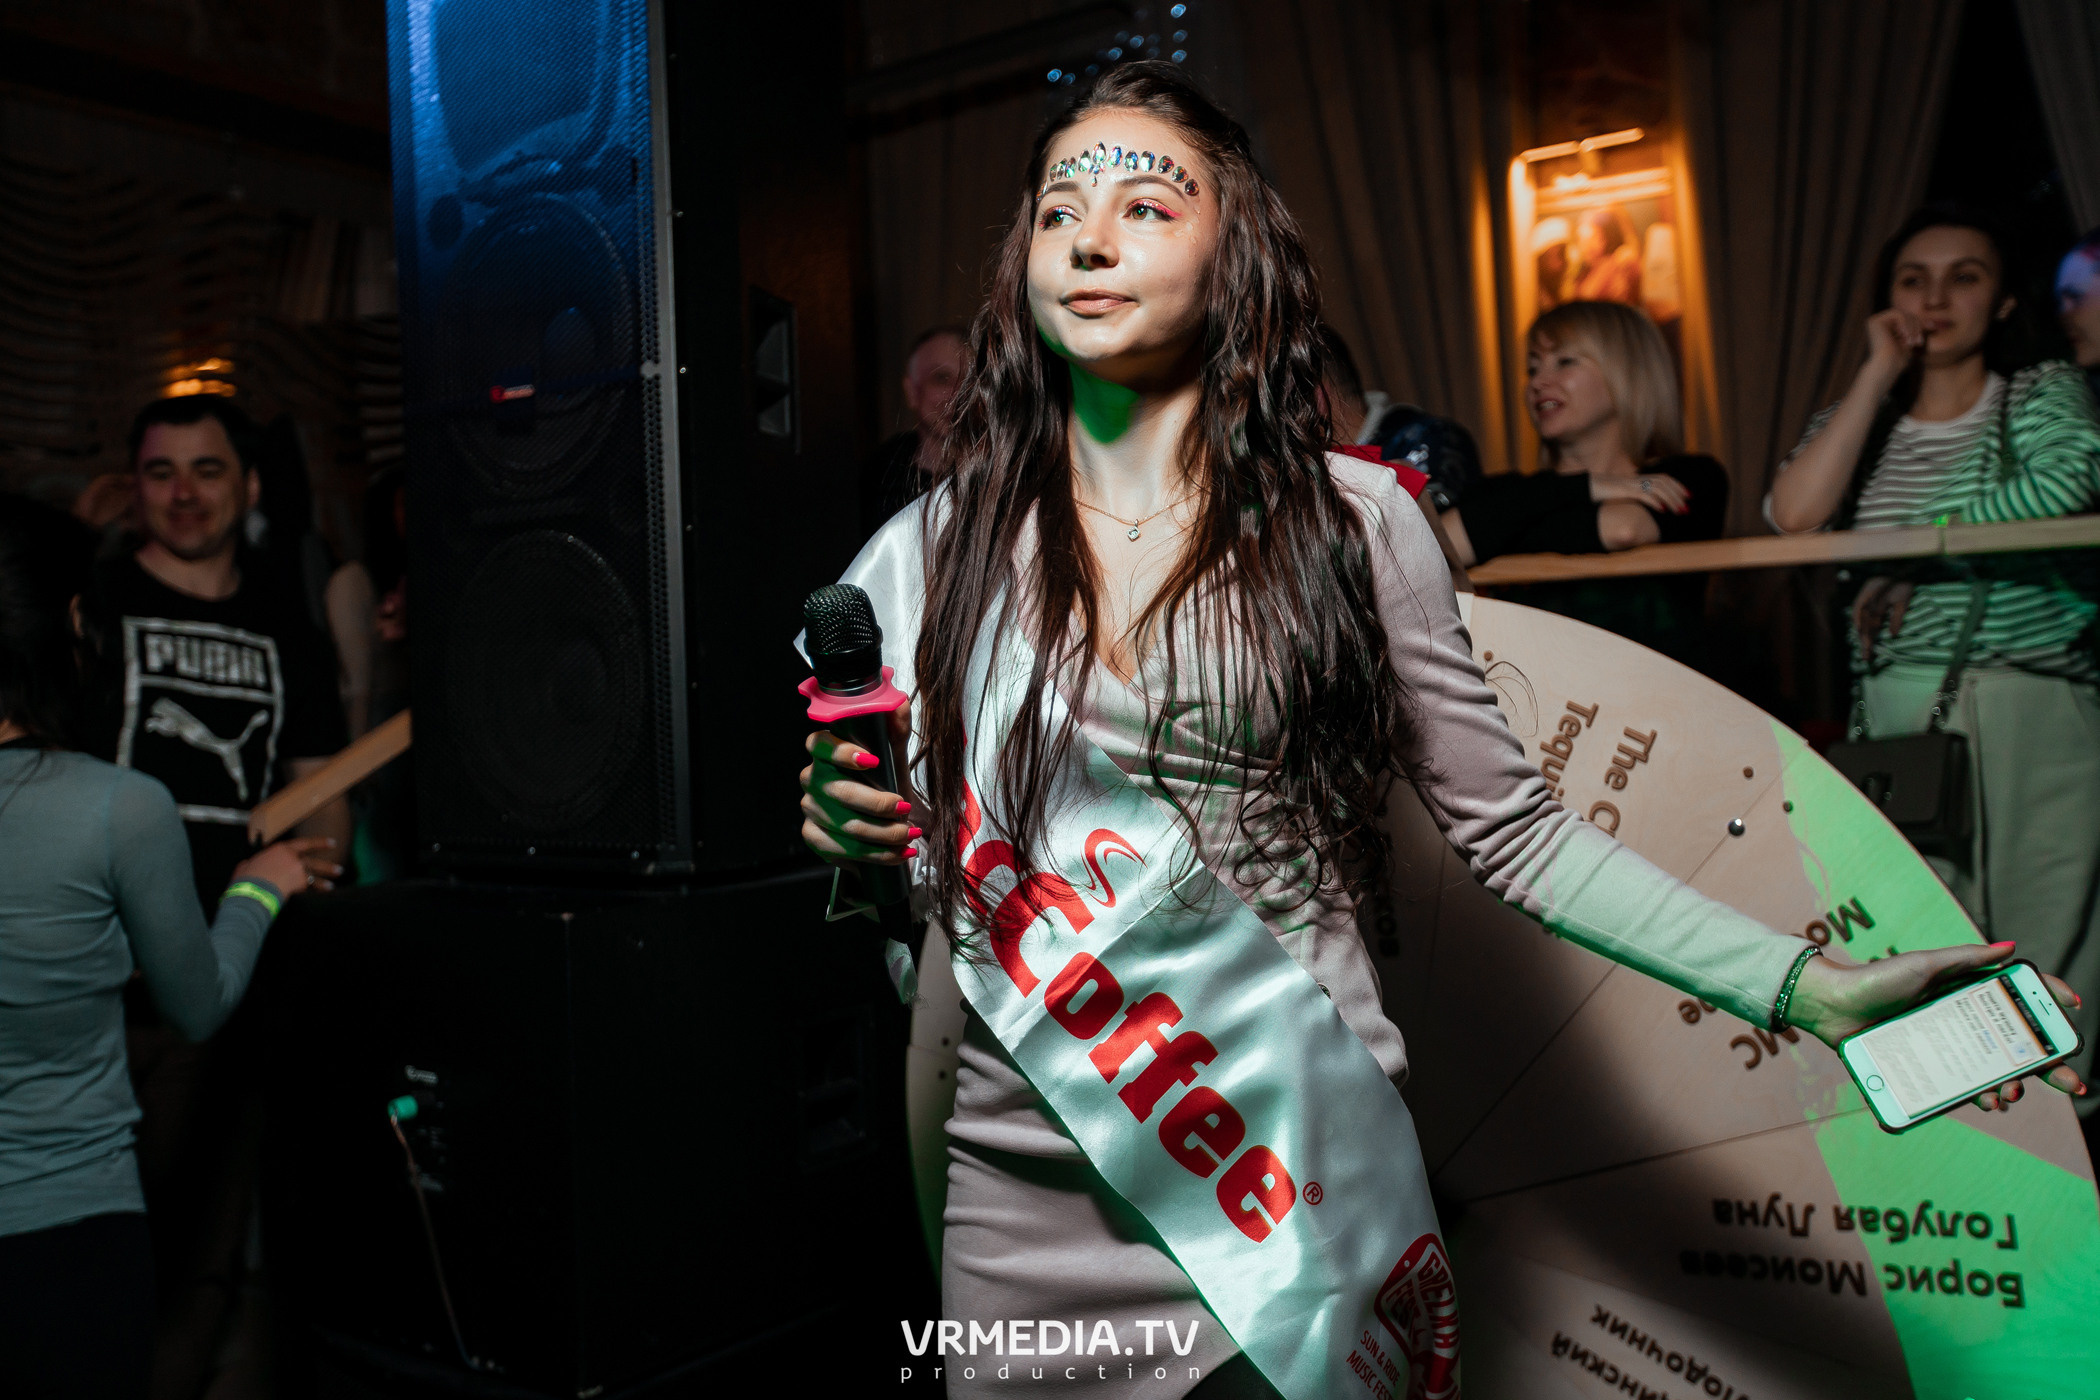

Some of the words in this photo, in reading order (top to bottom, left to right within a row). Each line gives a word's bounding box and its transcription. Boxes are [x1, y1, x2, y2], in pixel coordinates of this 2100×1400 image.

[145, 633, 266, 688] PUMA
[1603, 725, 1658, 791] The
[1711, 1192, 1816, 1238] Луна
[1832, 1199, 2020, 1251] Голубая
[1678, 1249, 1867, 1297] Моисеев
[1881, 1258, 2025, 1309] Борис
[1346, 1350, 1378, 1390] MUSIC
[1372, 1380, 1396, 1400] FES
[1360, 1330, 1380, 1361] SUN
[1377, 1351, 1387, 1366] &
[1383, 1358, 1402, 1389] RIDE
